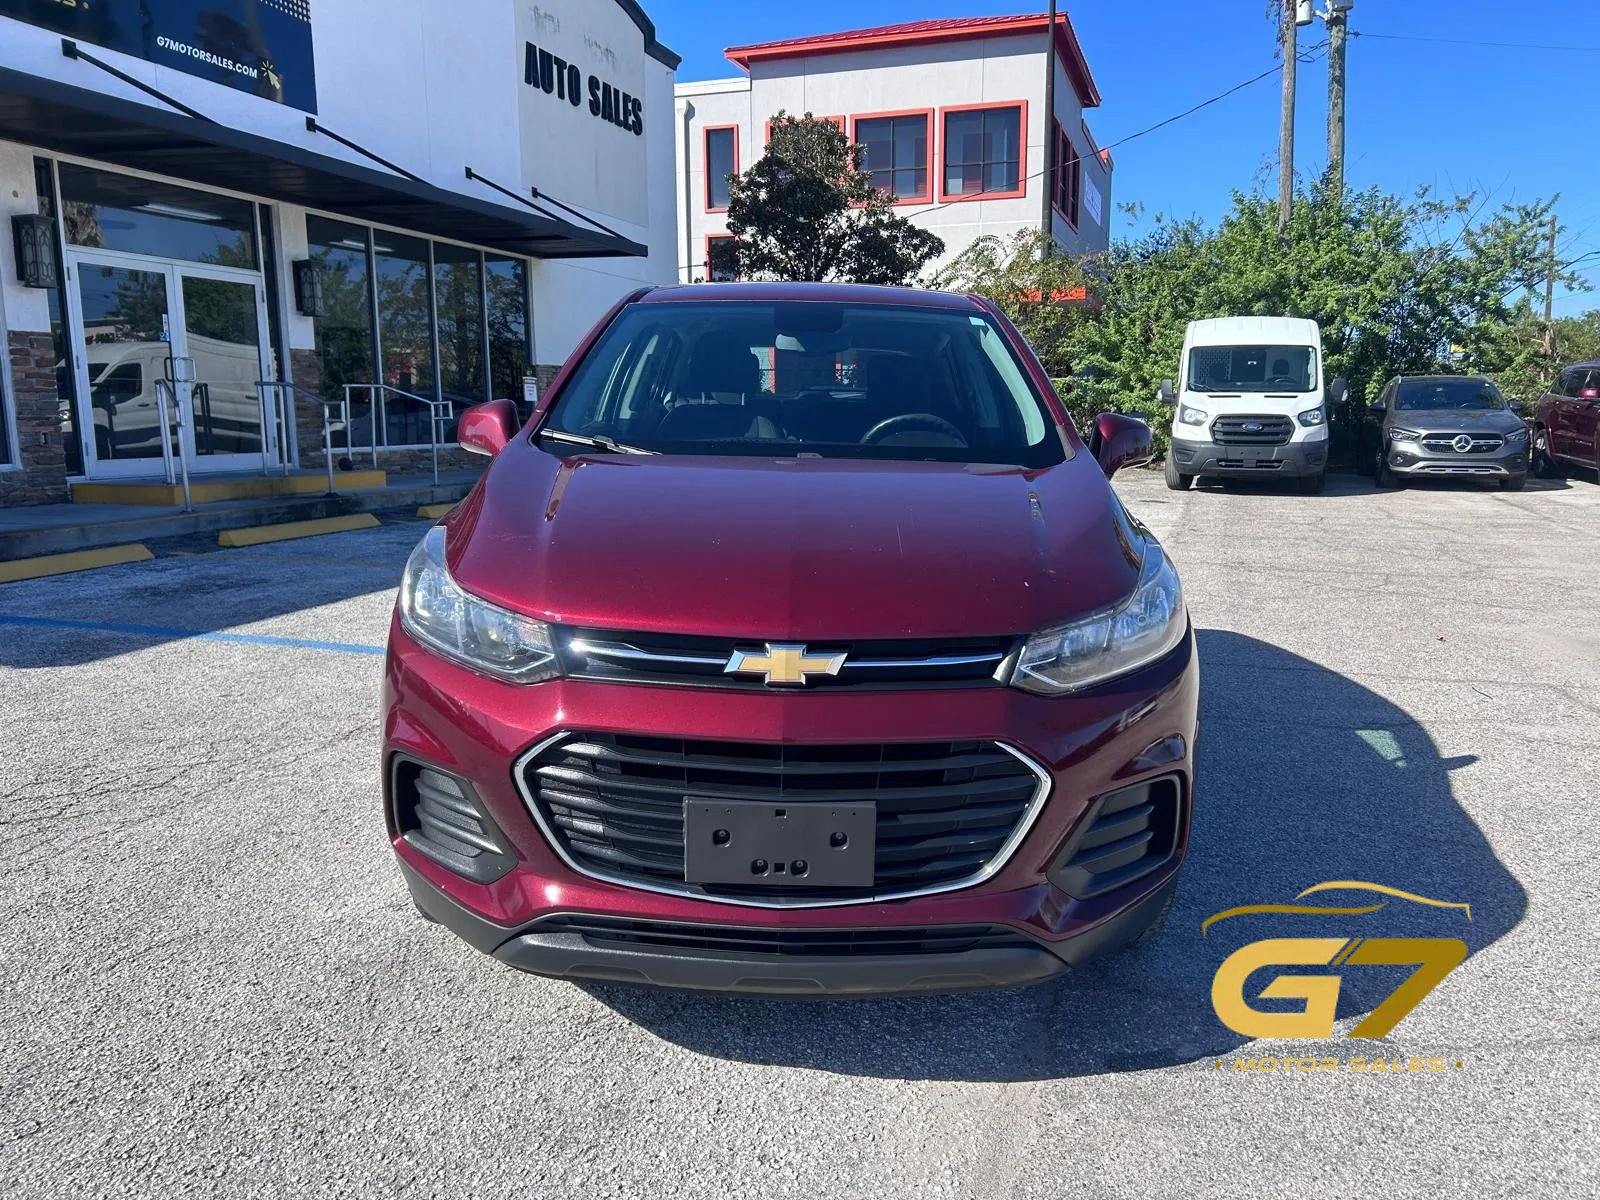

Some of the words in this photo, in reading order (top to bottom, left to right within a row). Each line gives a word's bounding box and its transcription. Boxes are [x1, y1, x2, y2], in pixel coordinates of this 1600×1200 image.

[156, 35, 258, 79] G7MOTORSALES.COM
[524, 41, 581, 107] AUTO
[588, 75, 643, 136] SALES
